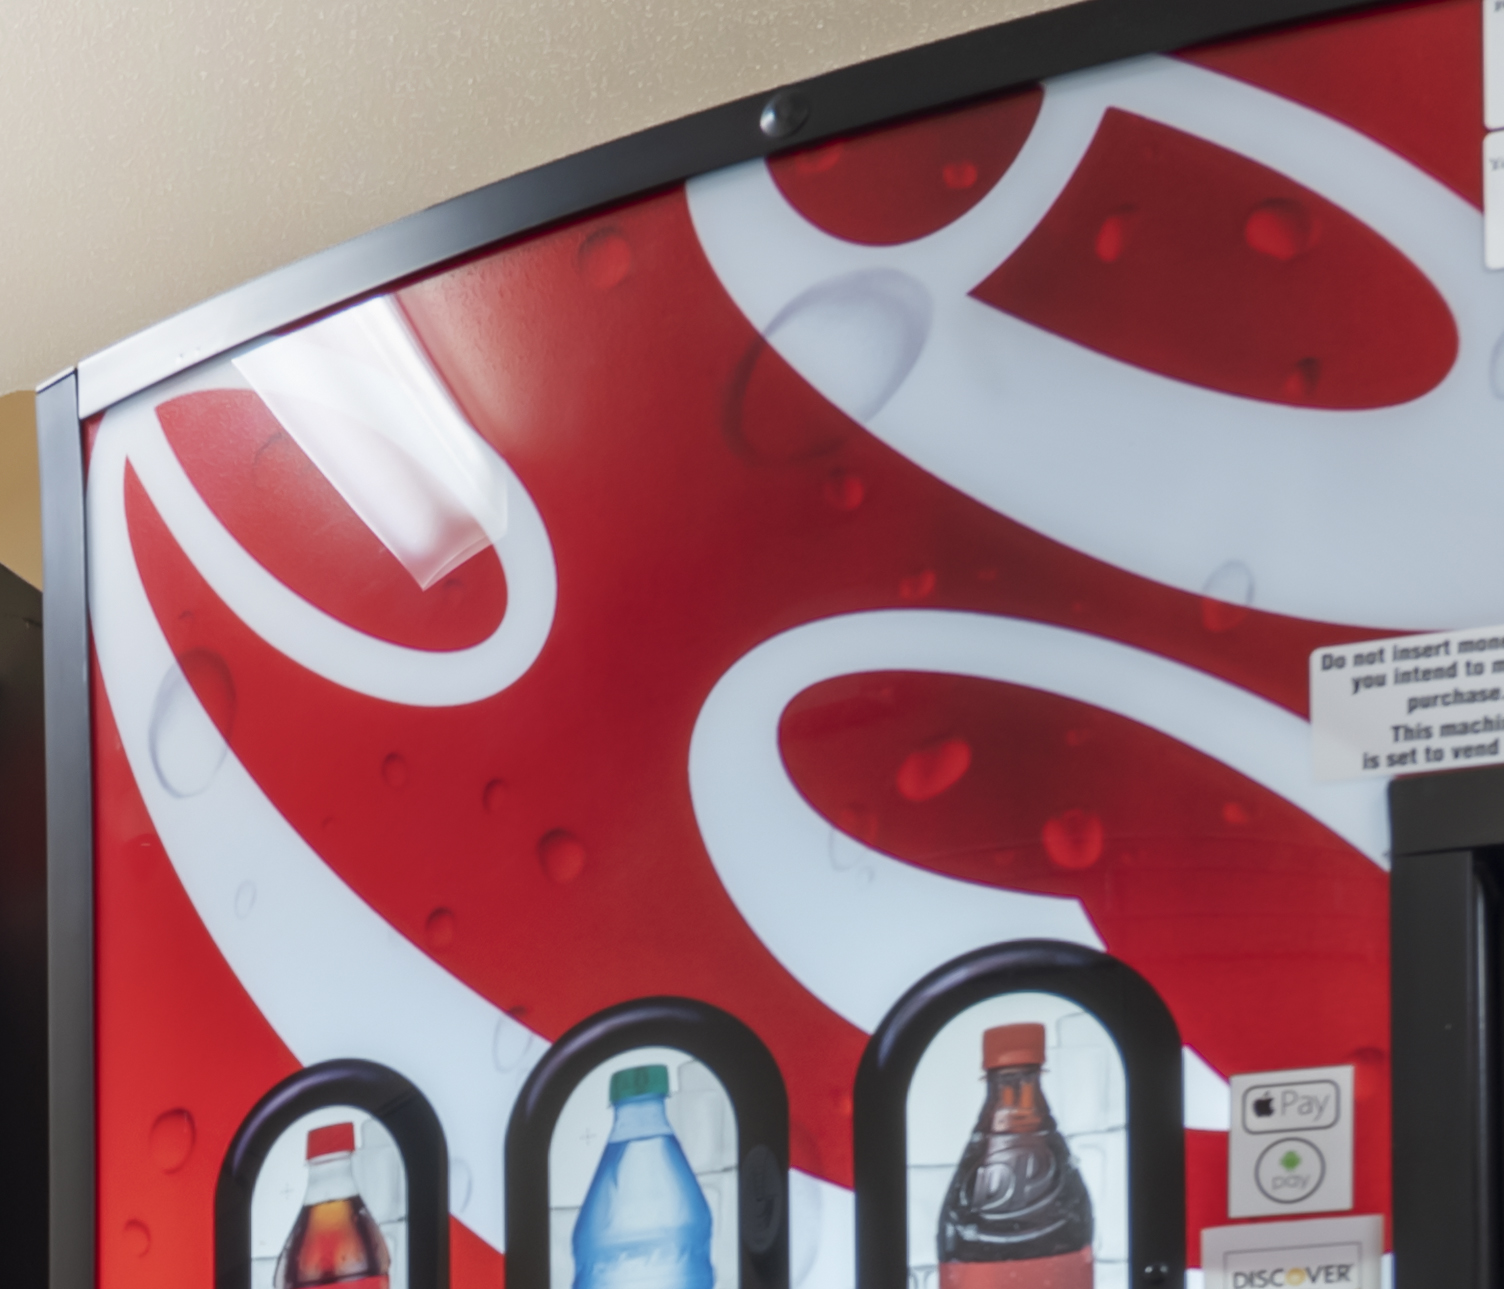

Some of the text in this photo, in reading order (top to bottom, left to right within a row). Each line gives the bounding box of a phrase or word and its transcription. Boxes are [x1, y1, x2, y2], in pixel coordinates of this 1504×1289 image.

[1320, 653, 1346, 671] Do
[1353, 649, 1385, 667] not
[1392, 640, 1451, 662] insert
[1352, 671, 1386, 694] you
[1393, 663, 1458, 685] intend
[1465, 660, 1485, 676] to
[1391, 723, 1433, 743] This
[1362, 752, 1380, 770] is
[1386, 747, 1418, 768] set
[1425, 746, 1445, 763] to
[1451, 738, 1500, 759] vend
[1279, 1090, 1331, 1122] Pay
[1270, 1171, 1312, 1192] pay
